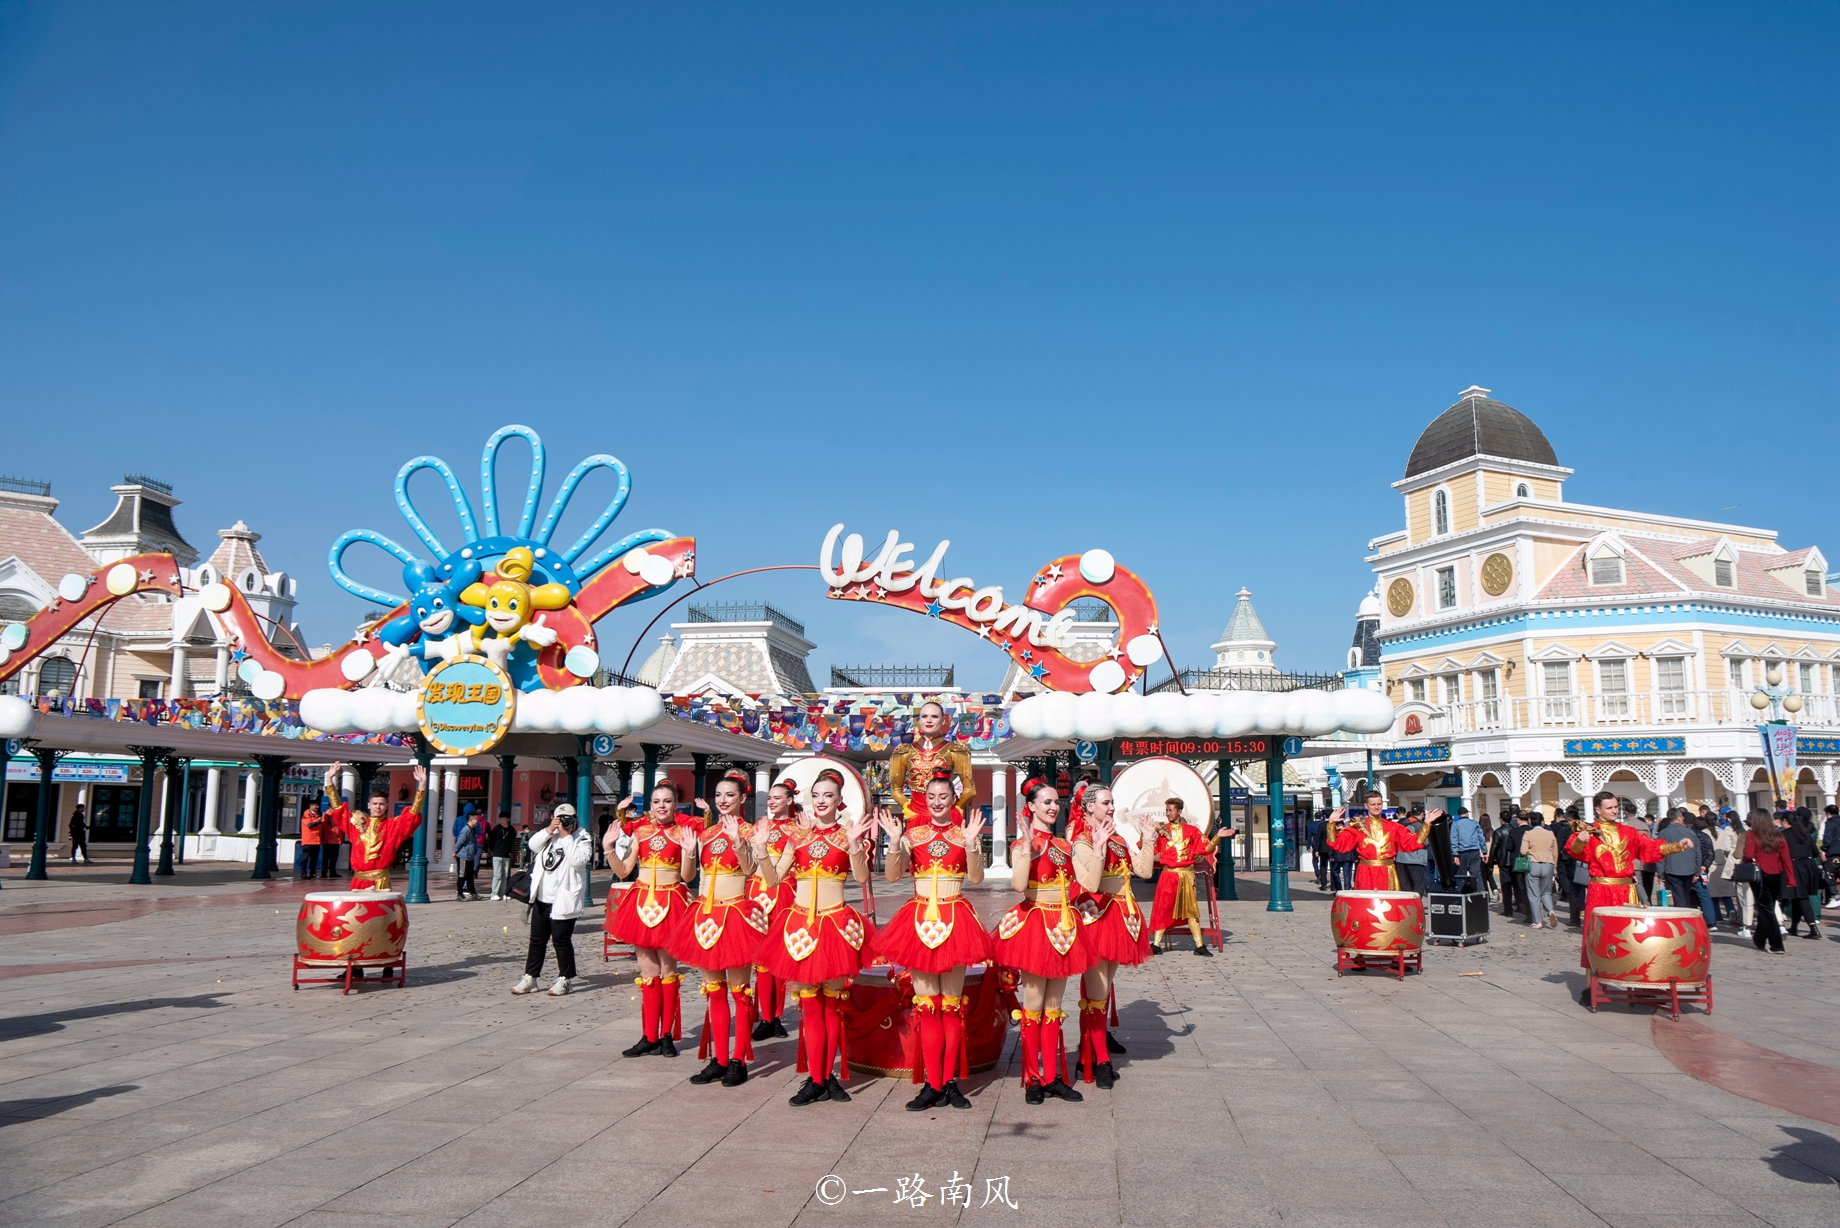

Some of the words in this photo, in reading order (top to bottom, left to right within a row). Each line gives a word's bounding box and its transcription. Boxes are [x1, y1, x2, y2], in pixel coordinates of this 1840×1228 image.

[426, 682, 502, 705] 发现王国
[1408, 718, 1417, 727] M
[9, 738, 18, 752] 5
[598, 736, 610, 752] 3
[1081, 741, 1093, 757] 2
[1120, 741, 1266, 756] 售票时间09:00-15:30
[1289, 739, 1297, 753] 1
[1591, 741, 1658, 751] 年卡中心
[460, 776, 483, 790] 团队
